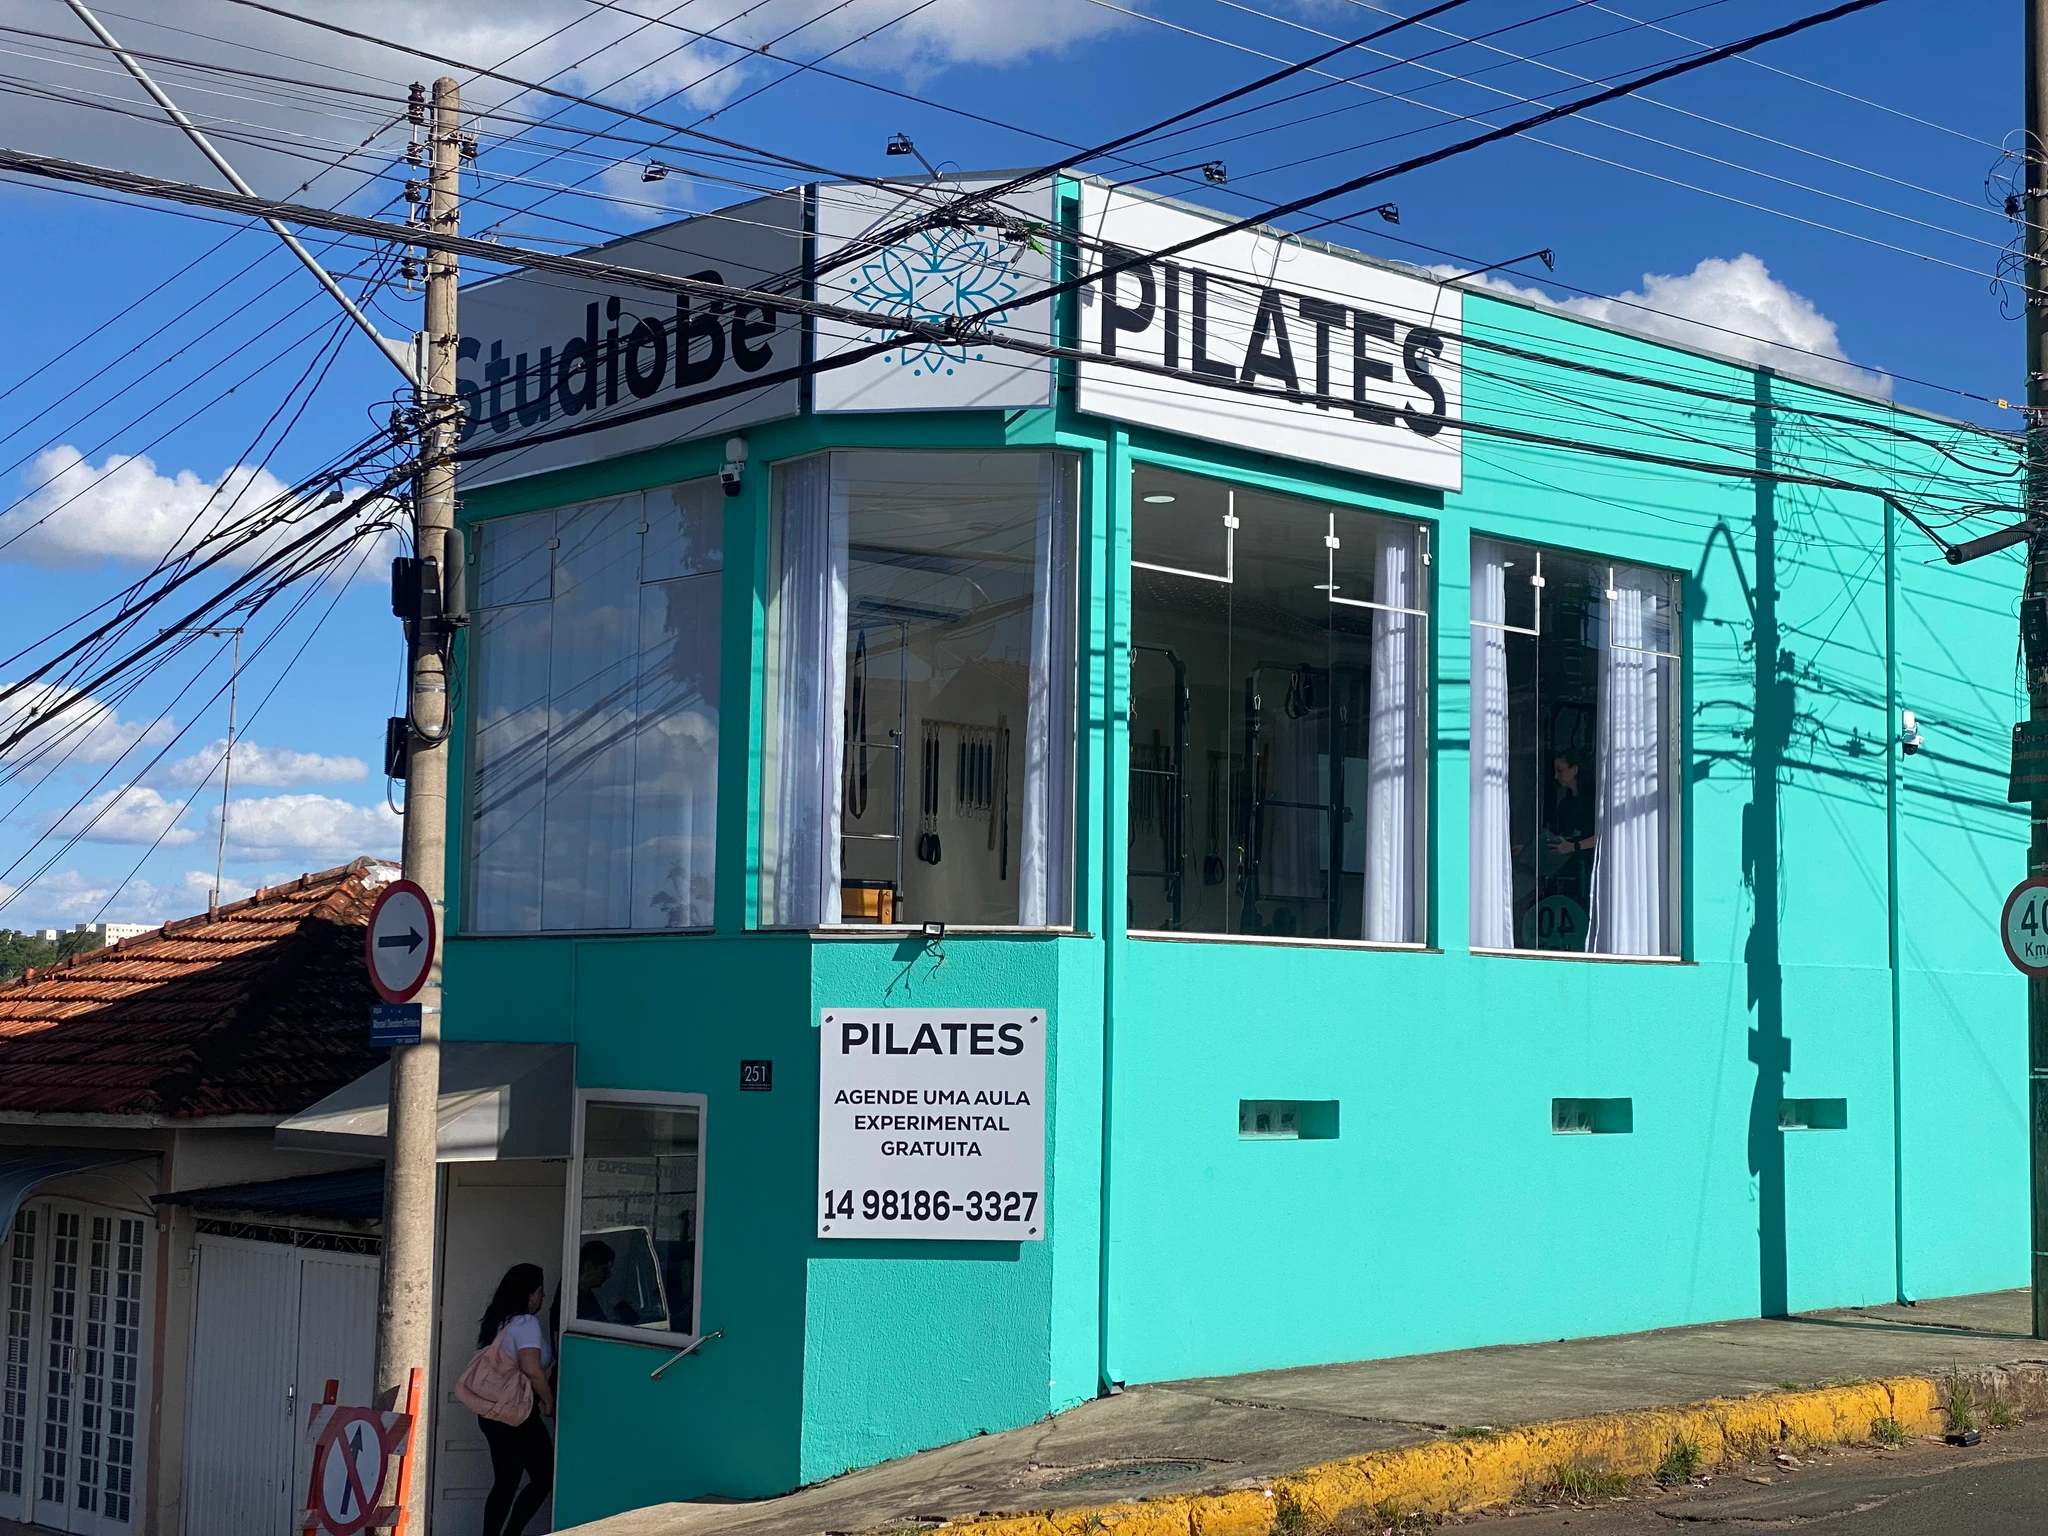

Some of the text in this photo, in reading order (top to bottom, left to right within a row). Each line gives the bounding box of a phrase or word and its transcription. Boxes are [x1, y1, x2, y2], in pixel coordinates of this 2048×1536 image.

[1101, 241, 1446, 437] PILATES
[842, 1022, 1025, 1056] PILATES
[744, 1065, 766, 1083] 251
[834, 1089, 1031, 1106] AGENDE UMA AULA
[854, 1115, 1010, 1131] EXPERIMENTAL
[880, 1141, 982, 1157] GRATUITA
[824, 1189, 1038, 1222] 14 98186-3327
